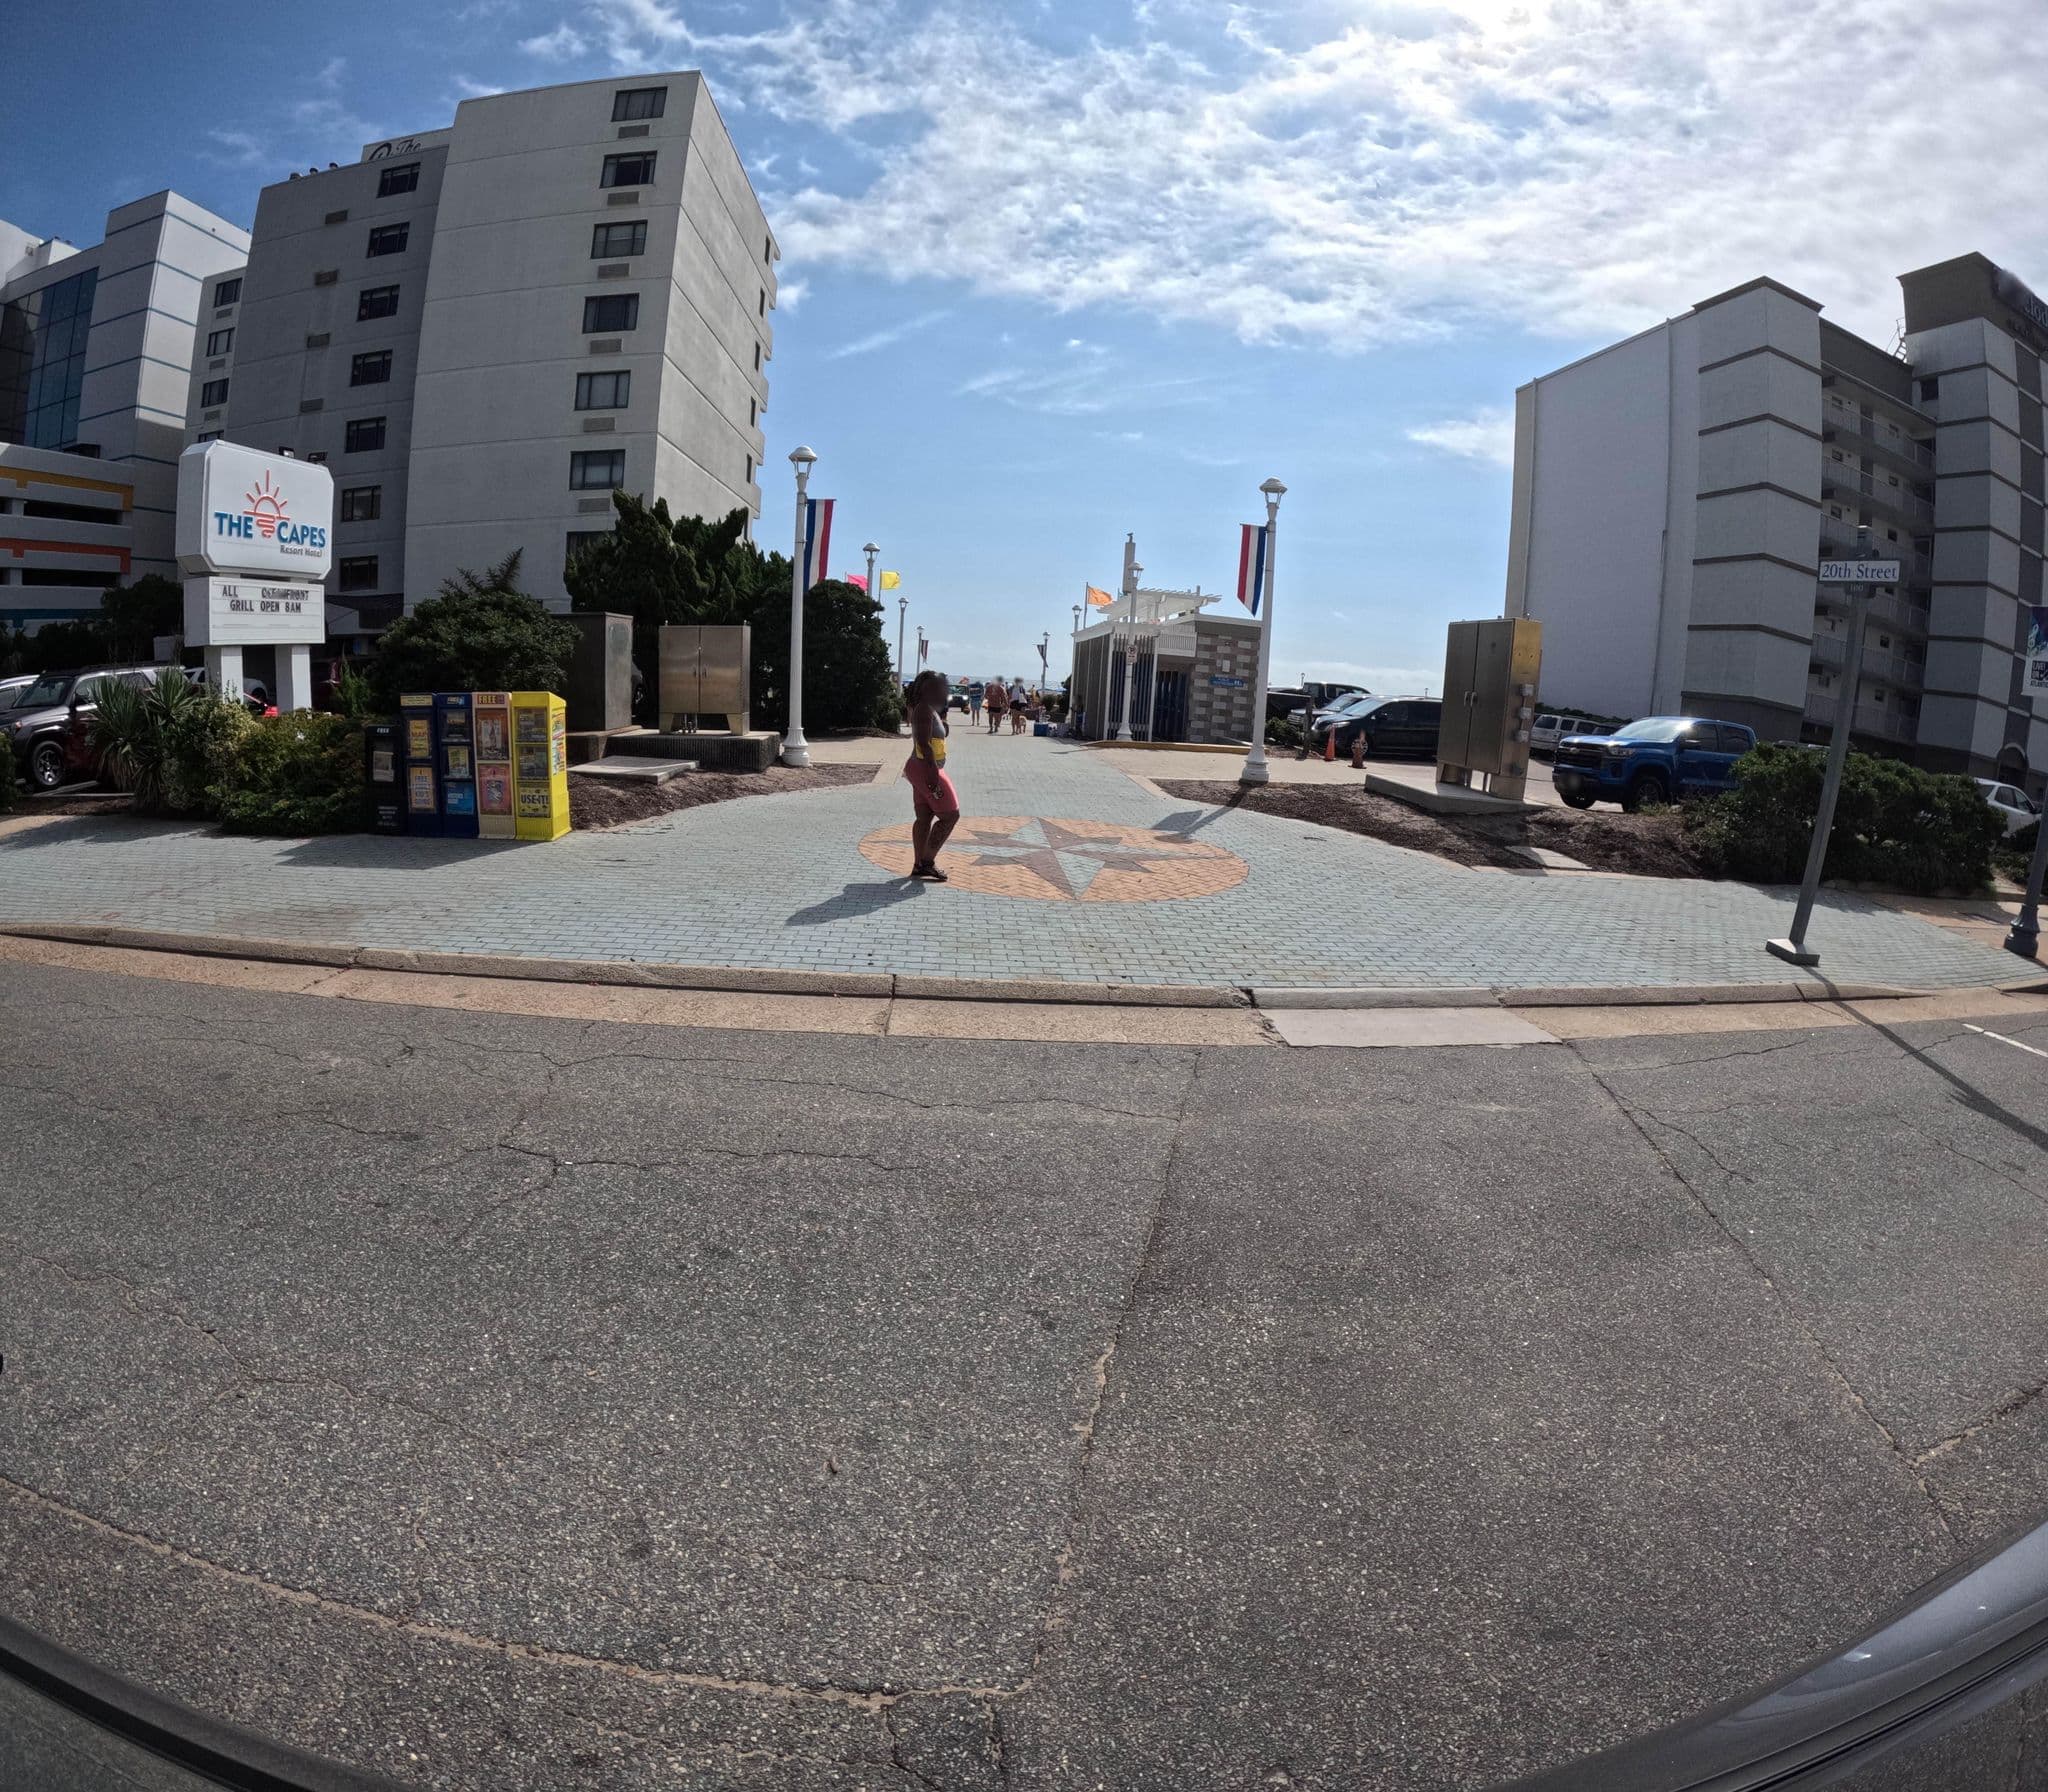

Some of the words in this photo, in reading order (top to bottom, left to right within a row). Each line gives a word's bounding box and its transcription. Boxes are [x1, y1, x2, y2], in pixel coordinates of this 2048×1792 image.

[214, 511, 253, 539] THE
[277, 521, 326, 549] CAPES
[280, 544, 304, 556] Resort
[1821, 563, 1851, 579] 20th
[1856, 563, 1897, 579] Street
[222, 585, 238, 598] ALL
[261, 587, 310, 601] OCEFRONT
[229, 599, 254, 612] GRILL
[260, 601, 280, 613] OPEN
[285, 602, 302, 613] 8AM
[478, 695, 497, 704] FREE
